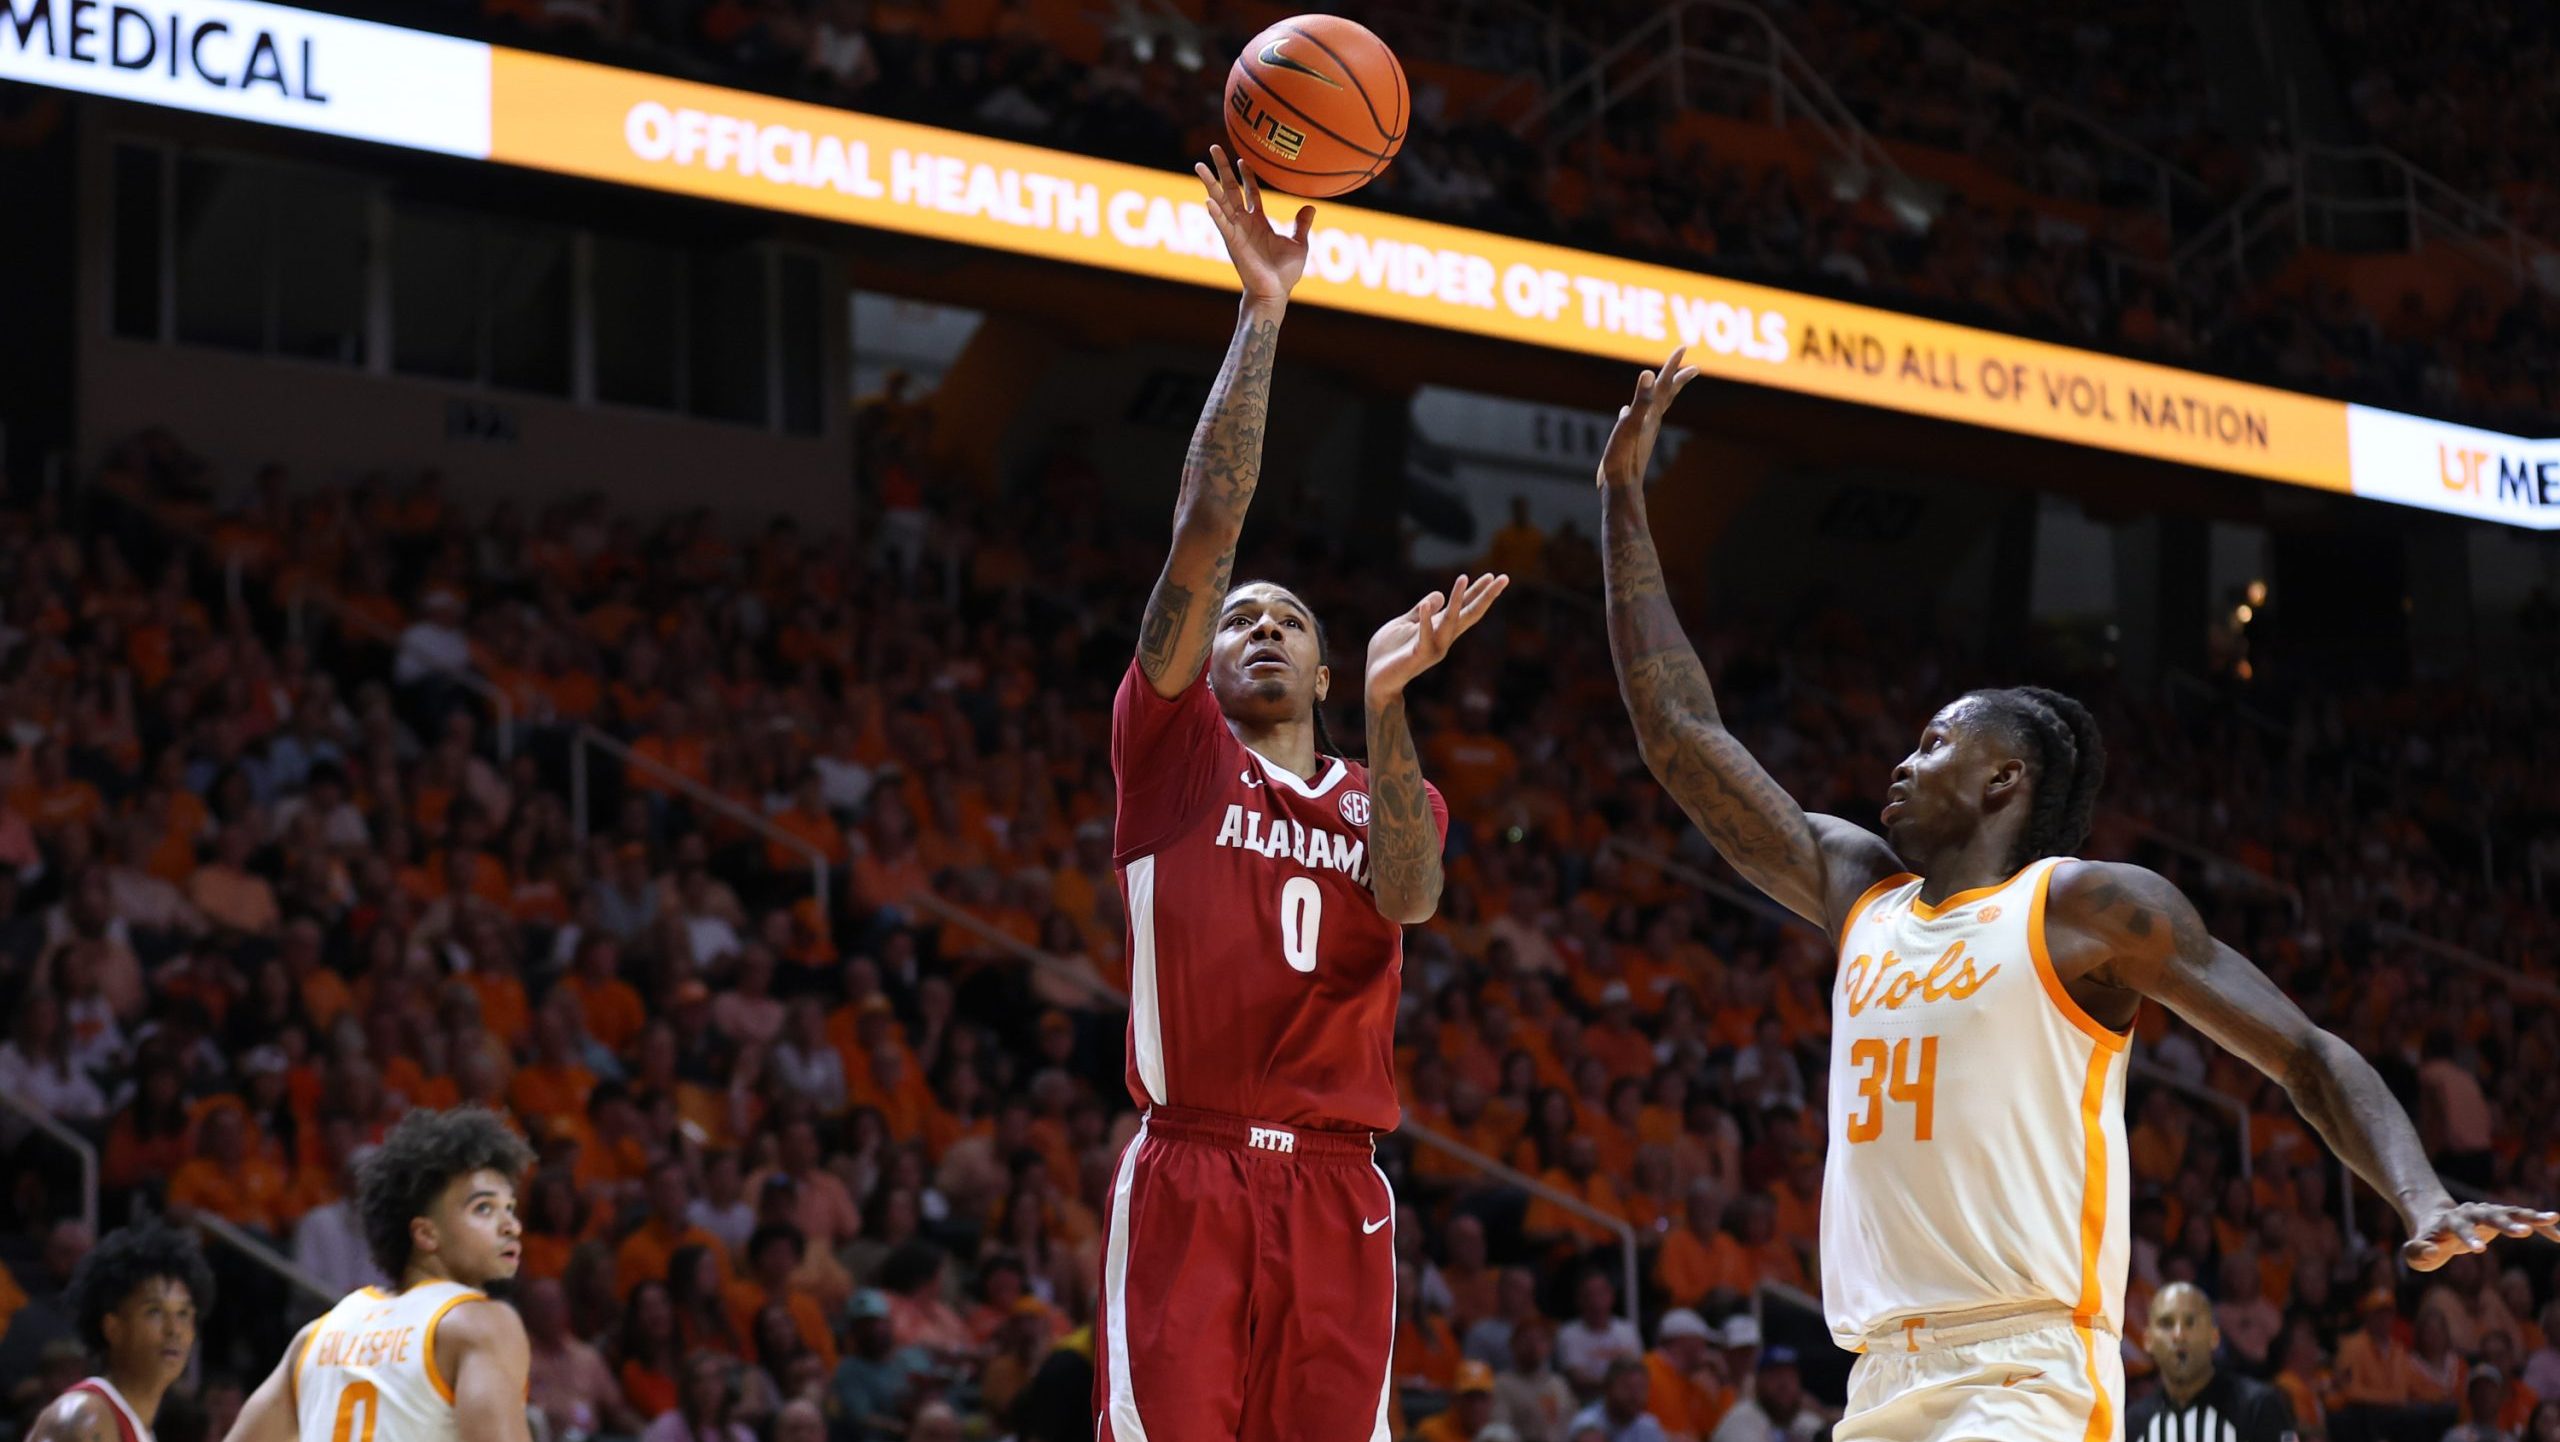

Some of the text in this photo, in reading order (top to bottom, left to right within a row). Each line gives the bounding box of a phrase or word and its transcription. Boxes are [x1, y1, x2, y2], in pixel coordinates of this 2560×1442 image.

[0, 0, 327, 102] MEDICAL
[625, 102, 884, 198] OFFICIAL
[891, 149, 1099, 237] HEALTH
[1503, 264, 1569, 320] OF
[1573, 277, 1666, 340] THE
[1671, 295, 1789, 363] VOLS
[1799, 325, 1886, 375] AND
[1899, 342, 1966, 392] ALL
[1979, 357, 2028, 402] OF
[2041, 370, 2116, 422] VOL
[2128, 387, 2268, 448] NATION
[2438, 443, 2560, 506] UT ME
[1281, 877, 1322, 972] 0
[1845, 940, 2001, 1018] Vols
[1847, 1036, 1940, 1144] 34
[1248, 1126, 1295, 1154] RTR
